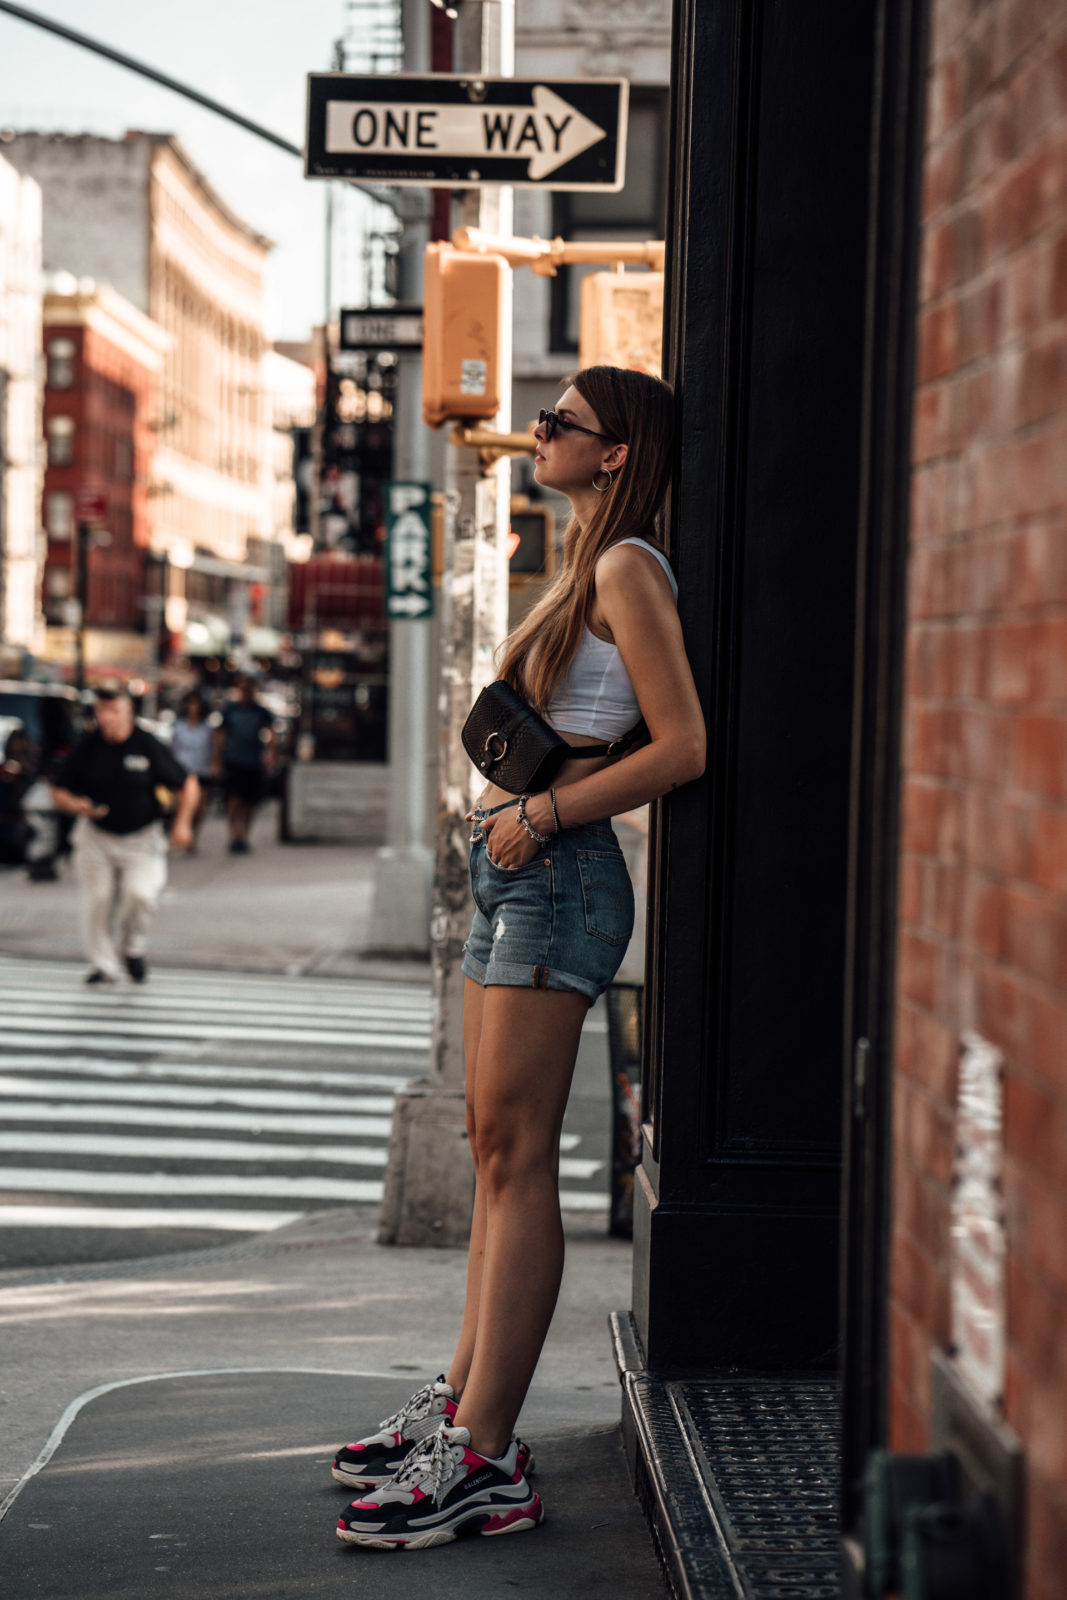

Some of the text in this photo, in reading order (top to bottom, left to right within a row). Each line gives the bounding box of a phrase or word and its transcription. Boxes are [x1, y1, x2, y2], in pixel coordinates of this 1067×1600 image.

[352, 109, 573, 153] ONE WAY
[390, 486, 428, 591] PARK
